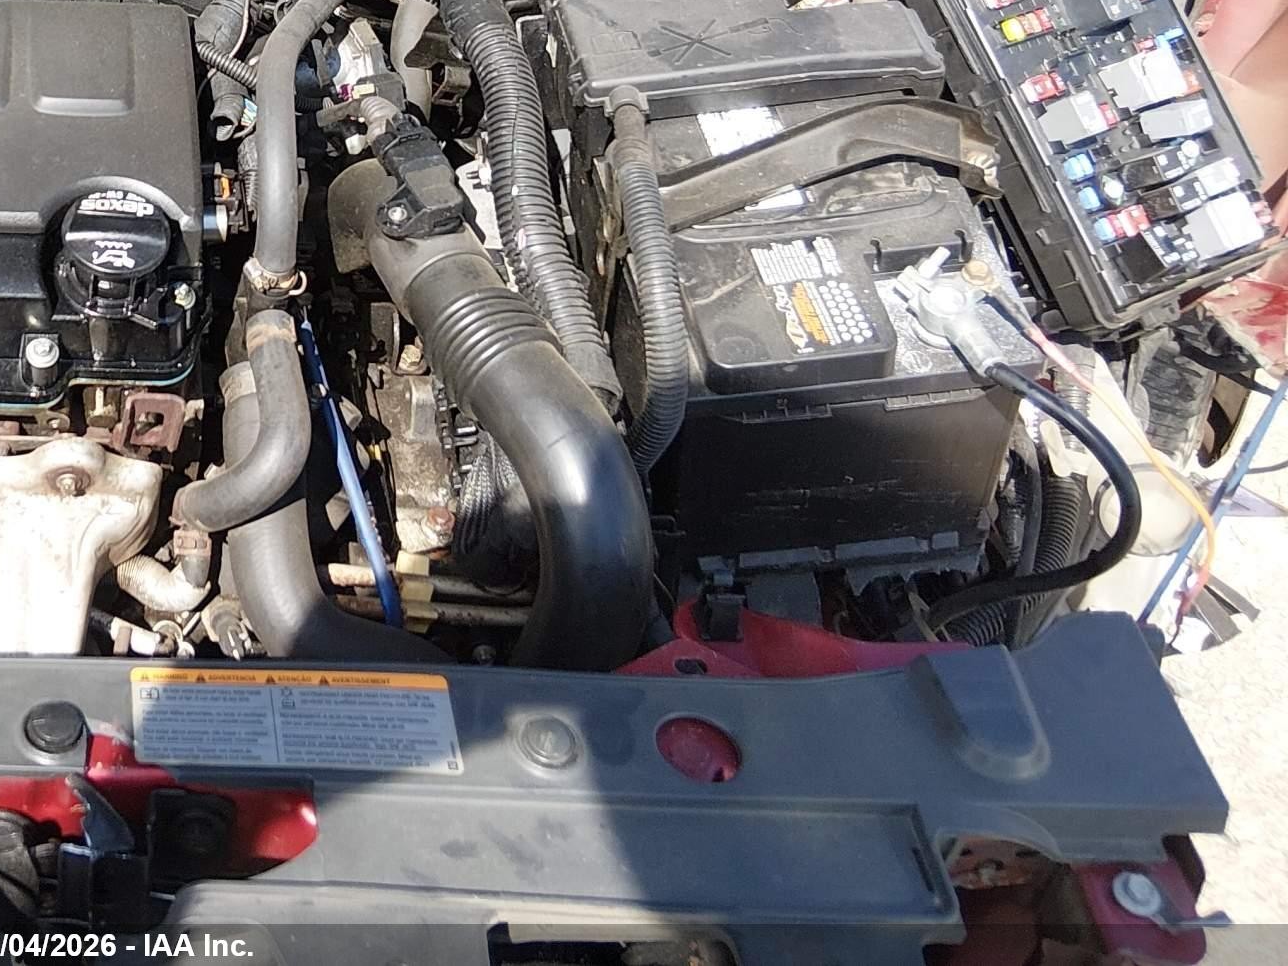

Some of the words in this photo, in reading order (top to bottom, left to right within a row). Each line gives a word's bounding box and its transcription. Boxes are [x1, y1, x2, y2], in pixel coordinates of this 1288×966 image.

[79, 199, 154, 218] dexos
[153, 673, 189, 681] WARNING
[208, 674, 257, 682] ADVERTENCIA
